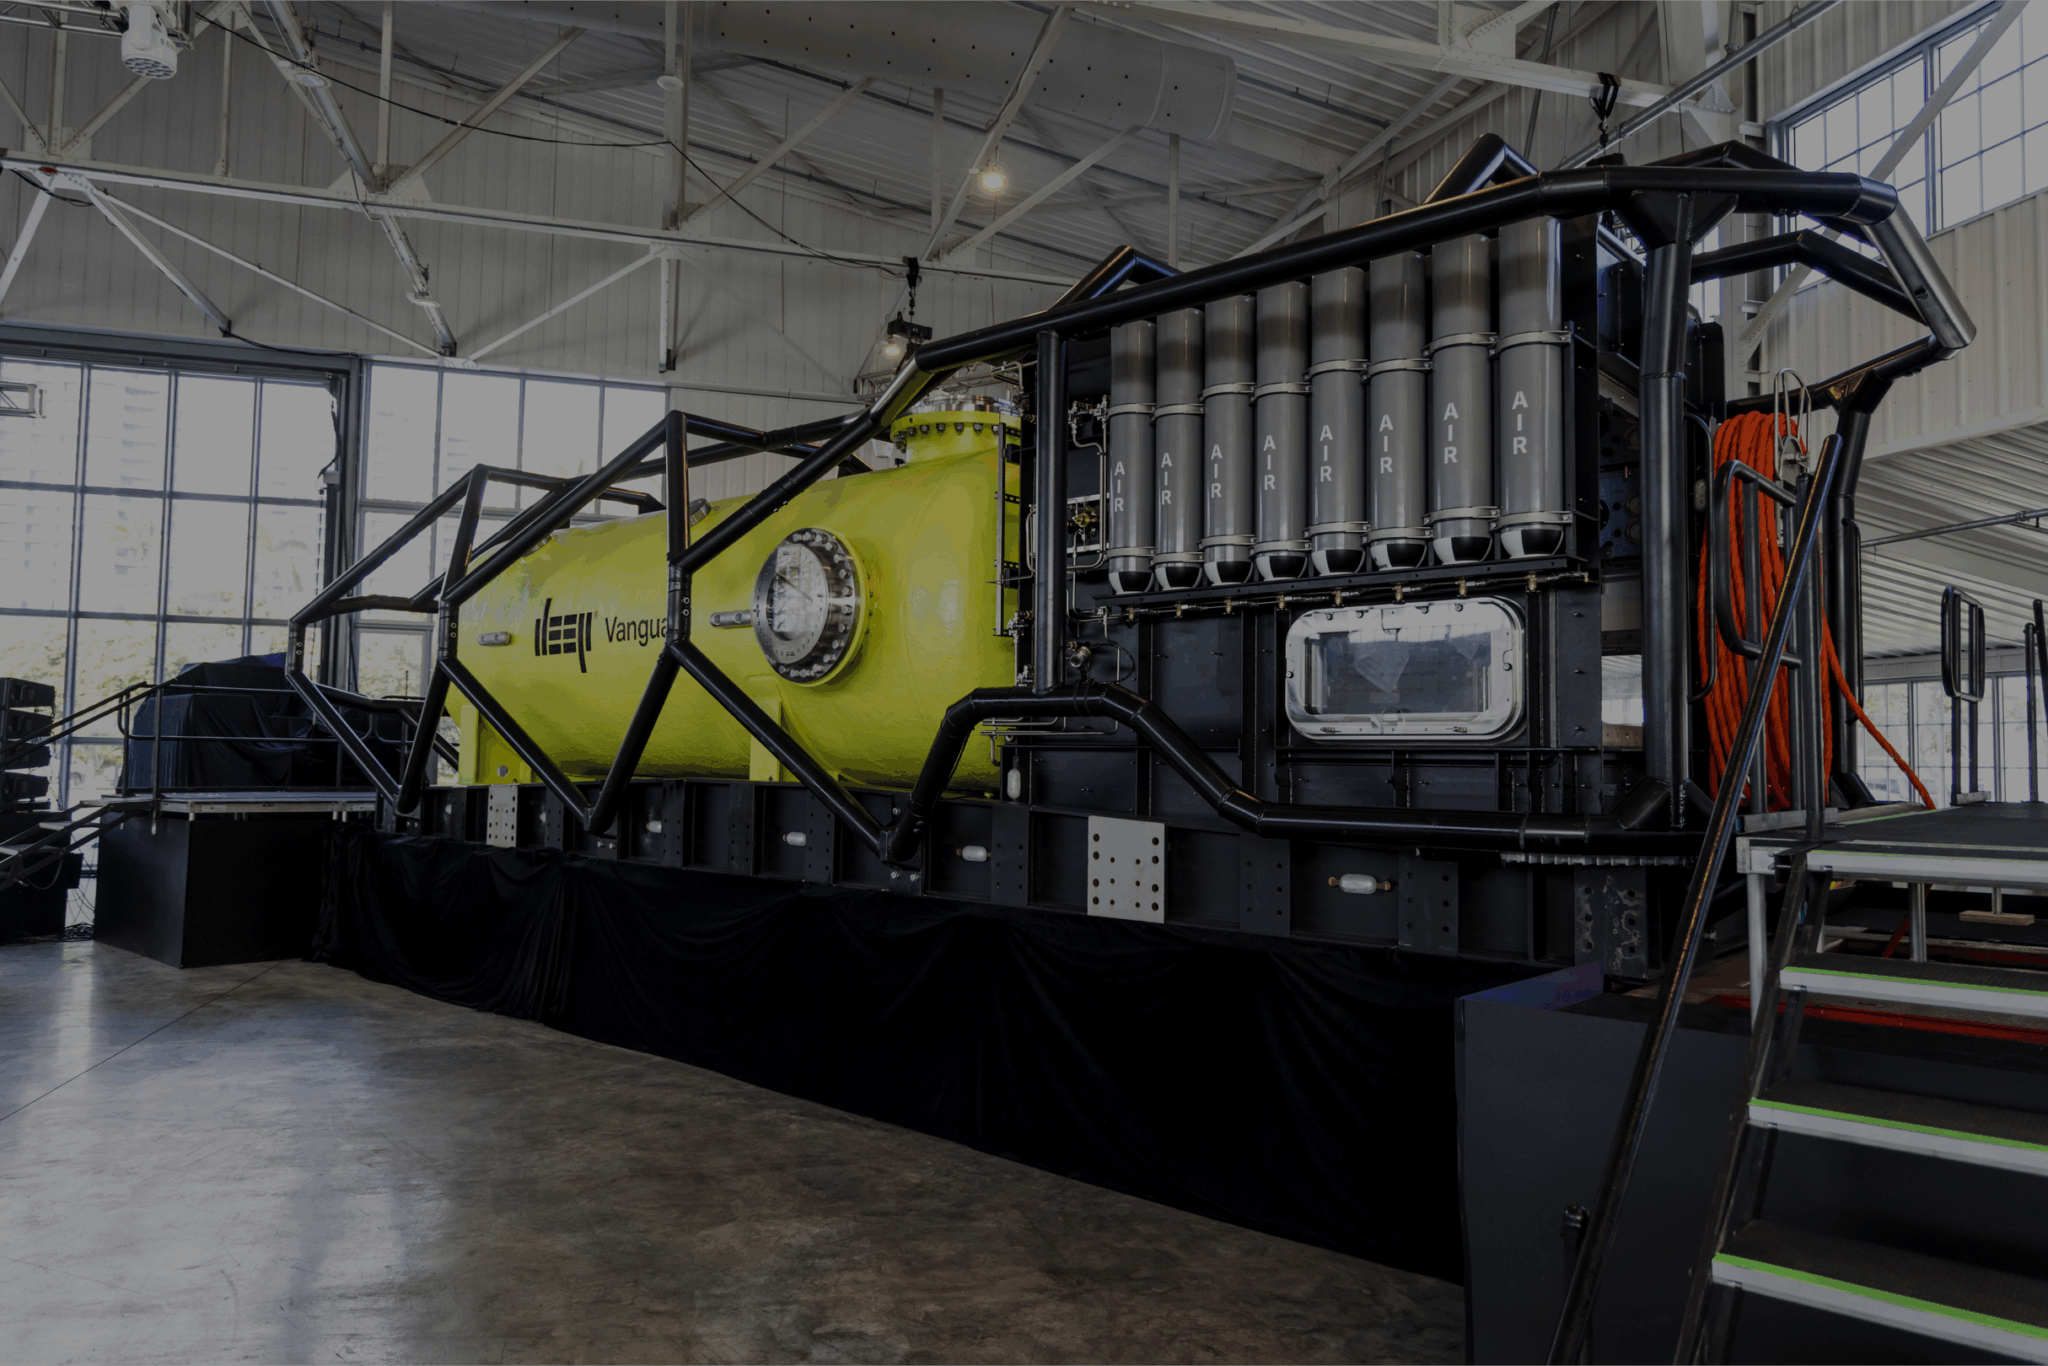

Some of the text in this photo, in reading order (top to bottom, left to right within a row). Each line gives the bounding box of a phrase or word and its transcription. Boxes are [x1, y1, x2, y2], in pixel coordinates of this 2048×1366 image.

[1379, 414, 1394, 474] AIR
[1443, 402, 1459, 464] AIR
[1511, 390, 1529, 455] AIR
[1161, 452, 1173, 505] AIR
[1210, 444, 1223, 499] AIR
[1263, 434, 1276, 491] AIR
[1319, 424, 1334, 482] AIR
[1114, 461, 1126, 512] AIR
